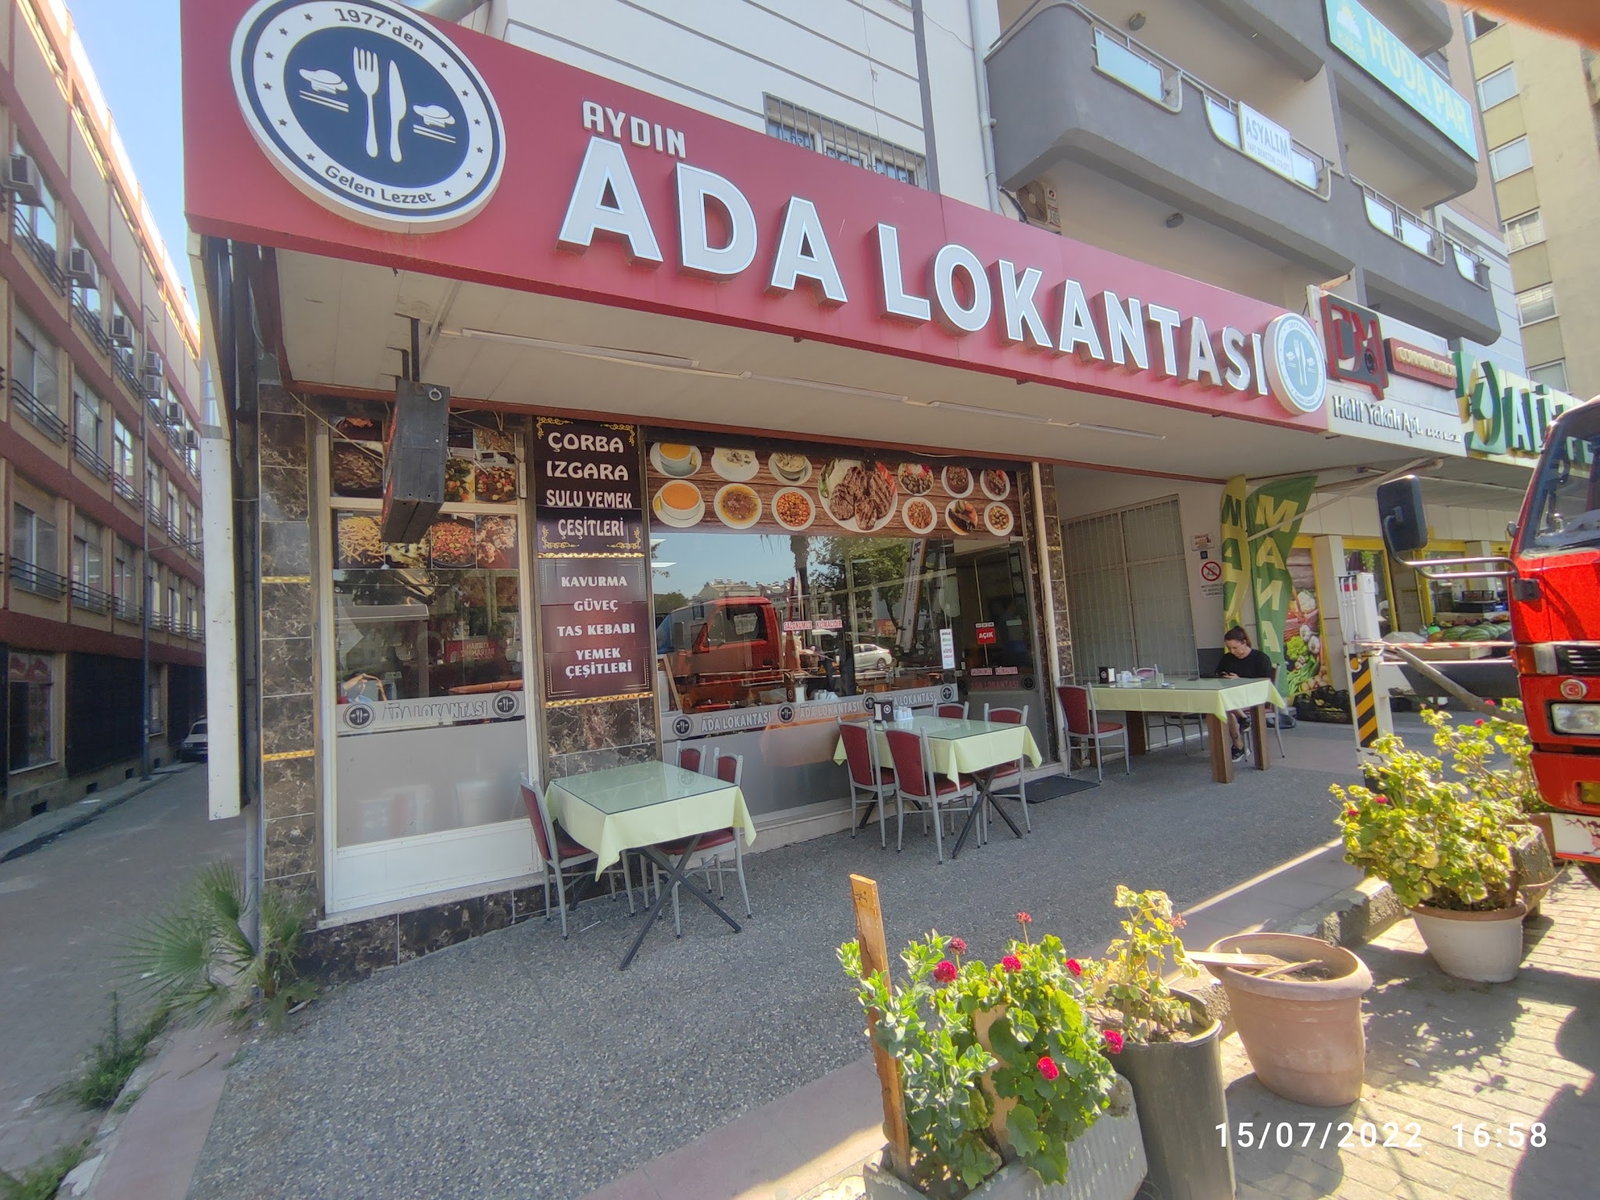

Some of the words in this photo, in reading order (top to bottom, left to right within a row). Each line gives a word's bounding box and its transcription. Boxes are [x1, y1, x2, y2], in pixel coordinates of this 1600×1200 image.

[334, 8, 424, 50] 1977'den
[1432, 76, 1470, 140] PAR
[582, 100, 686, 159] AYDIN
[325, 165, 375, 198] Gelen
[381, 188, 436, 204] Lezzet
[557, 135, 848, 306] ADA
[871, 223, 1268, 397] LOKANTASI
[1332, 395, 1363, 423] Halil
[1402, 411, 1423, 438] Apt.
[547, 432, 624, 453] ÇORBA
[546, 460, 629, 481] IZGARA
[546, 489, 583, 507] SULU
[587, 491, 632, 509] YEMEK
[557, 516, 624, 541] ÇEŞİTLERİ
[561, 576, 628, 588] KAVURMA
[573, 597, 618, 613] GÜVEÇ
[556, 626, 583, 637] TAS
[588, 623, 635, 635] KEBABI
[978, 631, 994, 639] AÇIK
[576, 648, 621, 660] YEMEK
[565, 659, 632, 678] ÇEŞİTLERİ
[382, 706, 412, 720] ADA
[414, 701, 488, 718] LOKANTASI
[701, 718, 721, 732] ADA
[722, 711, 771, 730] LOKANTASI
